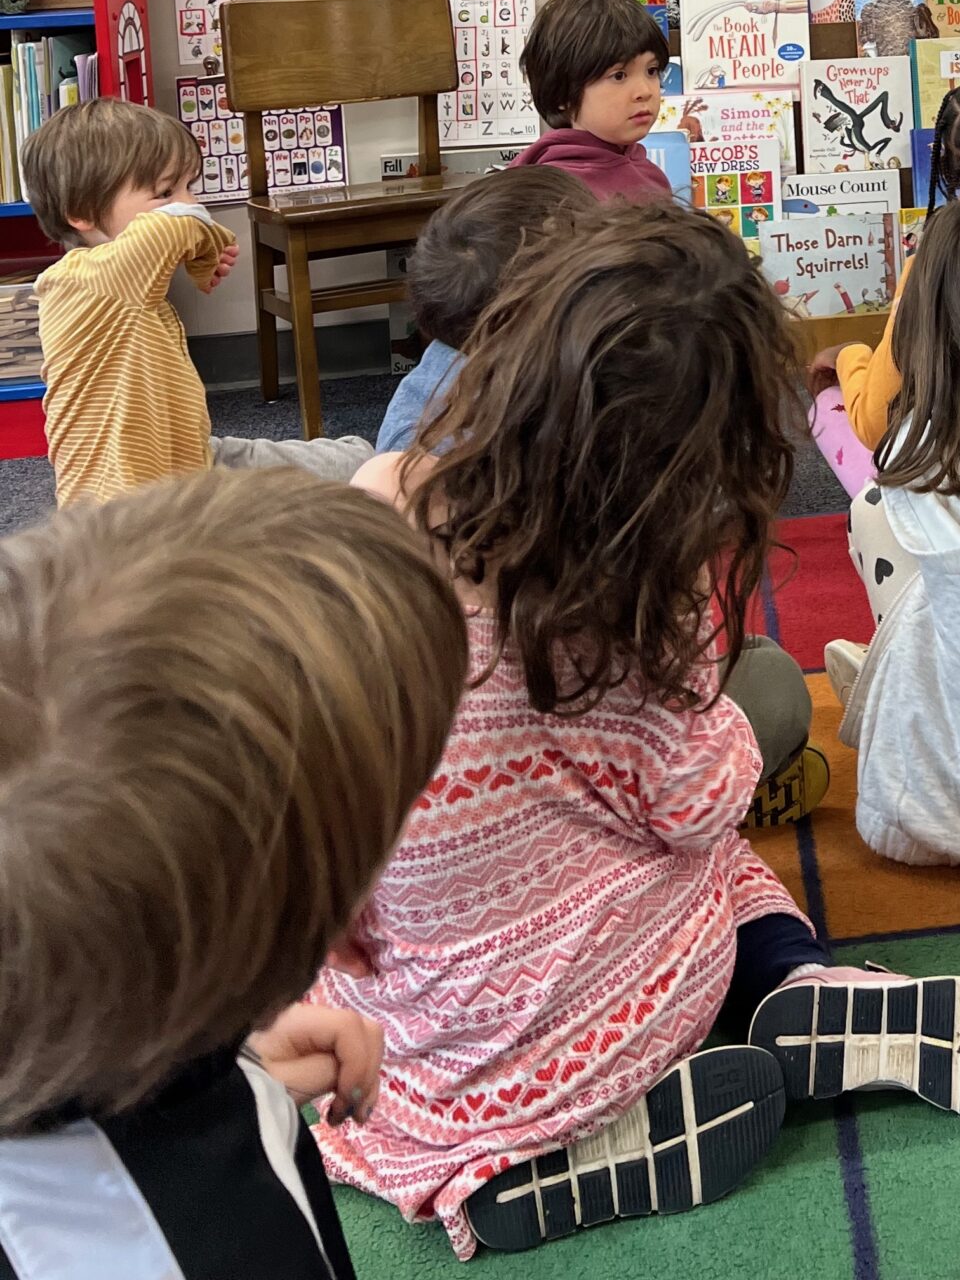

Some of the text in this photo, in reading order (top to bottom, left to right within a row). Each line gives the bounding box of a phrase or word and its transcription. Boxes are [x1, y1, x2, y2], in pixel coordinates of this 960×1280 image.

[723, 17, 760, 33] Book
[709, 33, 767, 59] MEAN
[733, 58, 785, 81] People
[721, 108, 771, 120] Simon
[690, 145, 759, 164] JACOB'S
[383, 160, 403, 173] Fall
[721, 159, 760, 173] DRESS
[786, 179, 888, 198] Mouse Count
[770, 228, 863, 253] Those Darn
[796, 252, 869, 279] Squirrels!
